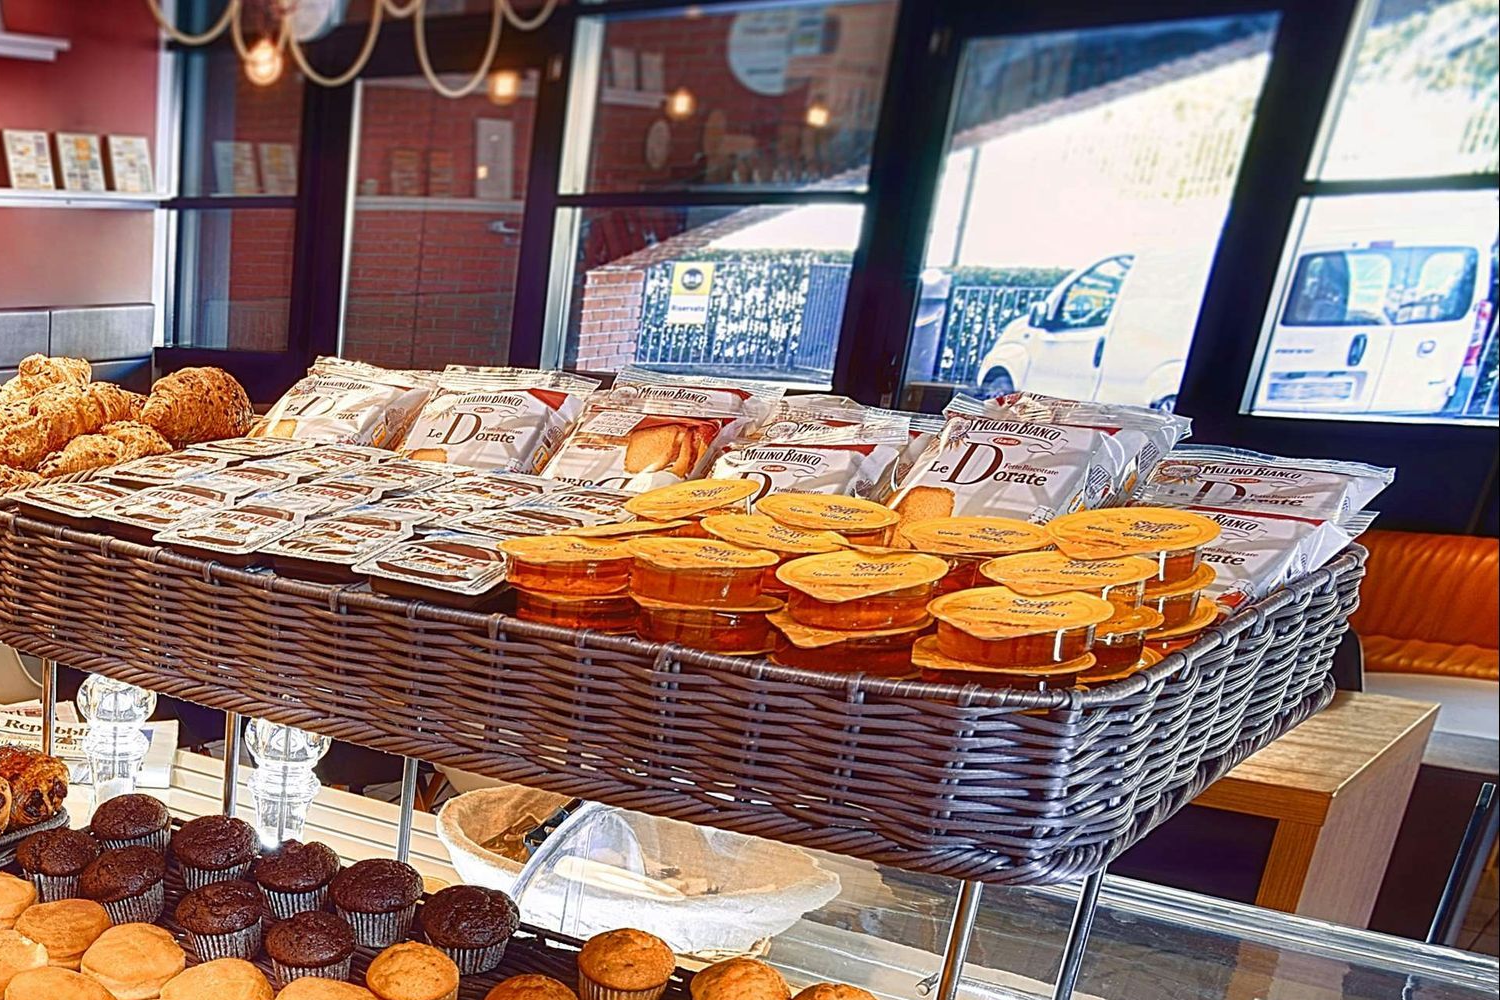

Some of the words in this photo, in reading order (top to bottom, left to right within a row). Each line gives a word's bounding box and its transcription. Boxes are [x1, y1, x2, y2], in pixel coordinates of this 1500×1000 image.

[639, 386, 674, 400] MULINO
[672, 388, 708, 404] BIANCO
[285, 403, 299, 412] Le
[426, 428, 443, 439] Le
[437, 412, 516, 446] Dorate
[970, 418, 1020, 434] MULINO
[1016, 422, 1062, 440] BIANCO
[743, 448, 783, 461] MULINO
[782, 448, 822, 466] BIANCO
[928, 460, 949, 475] Le
[940, 442, 1048, 487] Dorate
[1003, 463, 1023, 472] Fette
[1022, 464, 1060, 476] Biscottate
[1202, 465, 1254, 477] MULINO
[1255, 466, 1303, 480] BIANCO
[293, 486, 355, 500] nutella
[467, 481, 532, 497] nutella
[558, 495, 623, 506] nutell
[210, 511, 278, 527] nutella
[1212, 513, 1259, 532] BIANCO
[311, 522, 385, 539] nutella
[1201, 552, 1246, 566] rate
